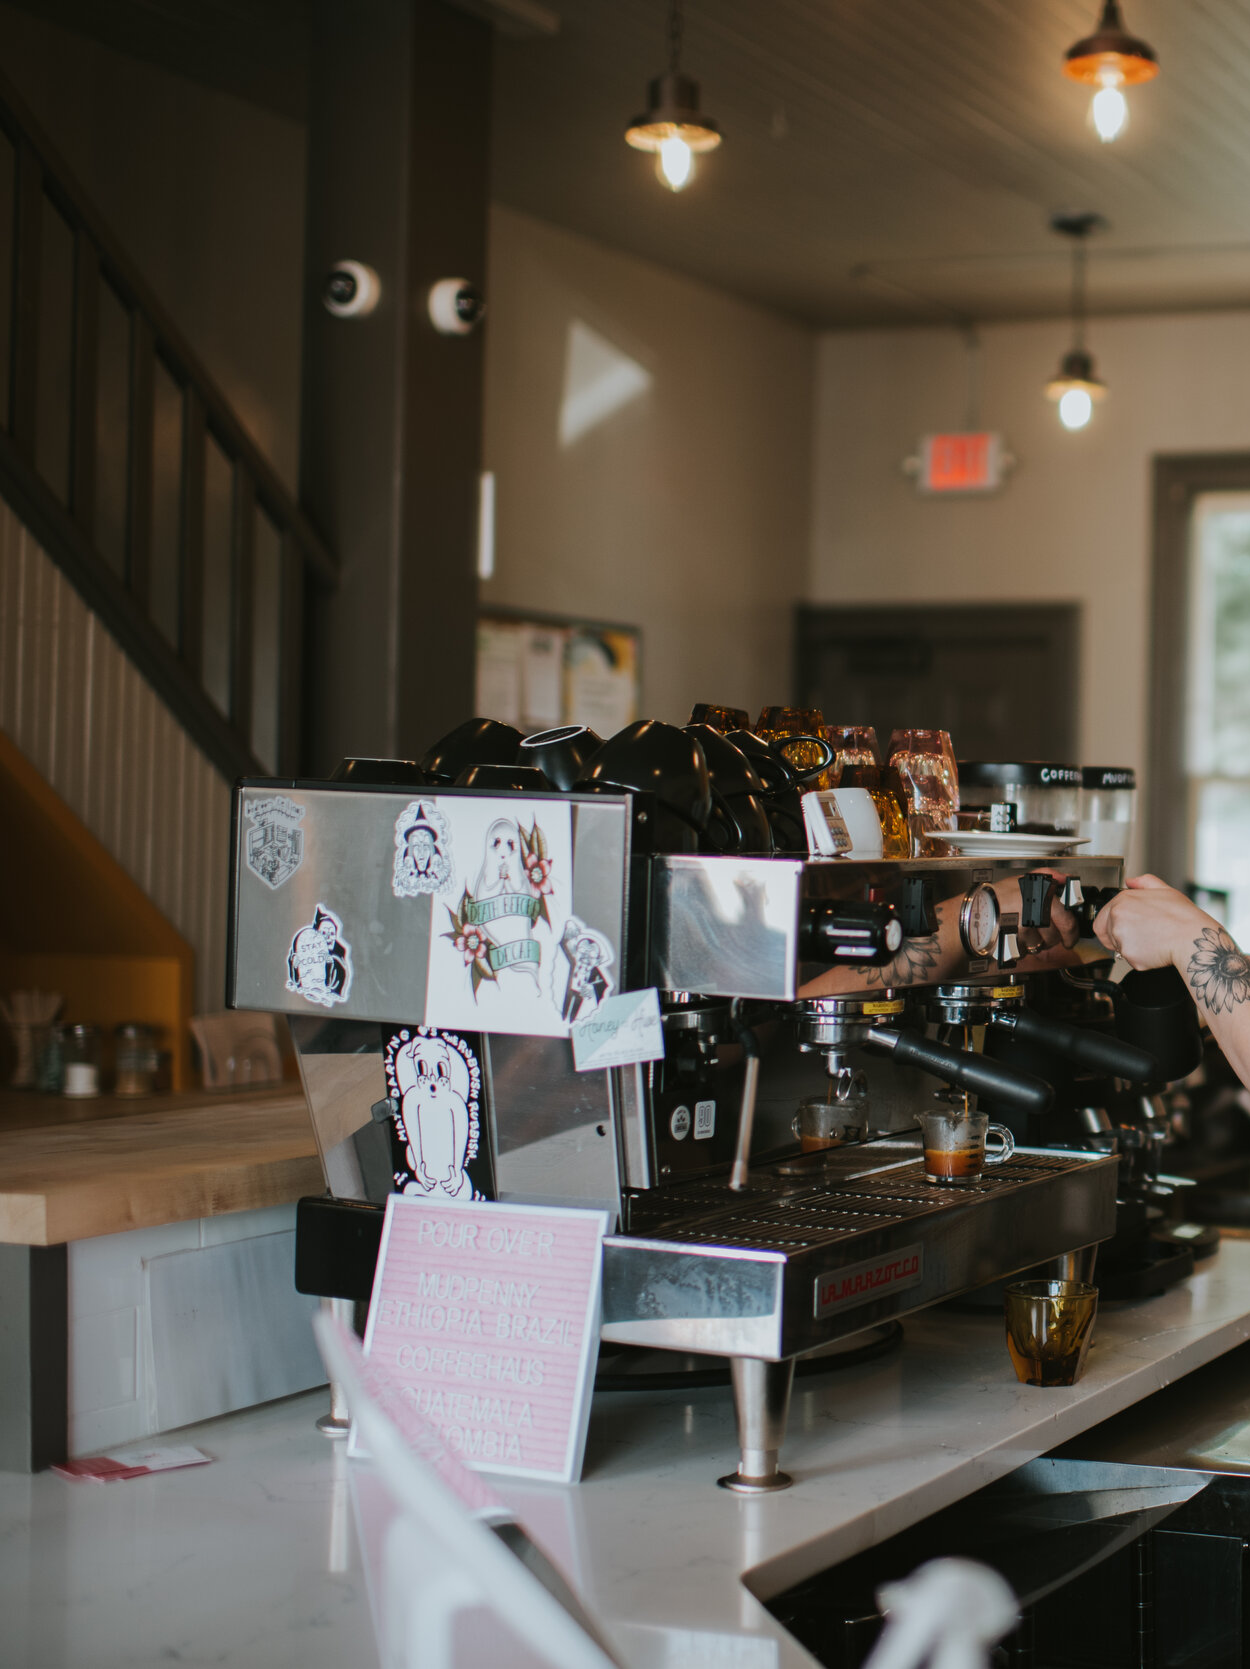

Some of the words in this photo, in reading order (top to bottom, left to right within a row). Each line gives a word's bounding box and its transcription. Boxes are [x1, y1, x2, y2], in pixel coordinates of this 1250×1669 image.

[470, 901, 498, 922] DEATH
[301, 942, 322, 953] STAY
[302, 955, 325, 966] COLD
[497, 941, 531, 966] DECAF
[441, 1031, 459, 1047] THE
[384, 1029, 409, 1098] DARLING
[393, 1113, 408, 1142] MAT
[417, 1219, 478, 1250] POUR
[487, 1228, 555, 1257] OVER
[416, 1271, 541, 1310] MUDPENNY
[377, 1300, 483, 1335] ETHIOPIA
[495, 1313, 575, 1347] BRAZIL
[396, 1344, 544, 1386] COFFEEHAUS
